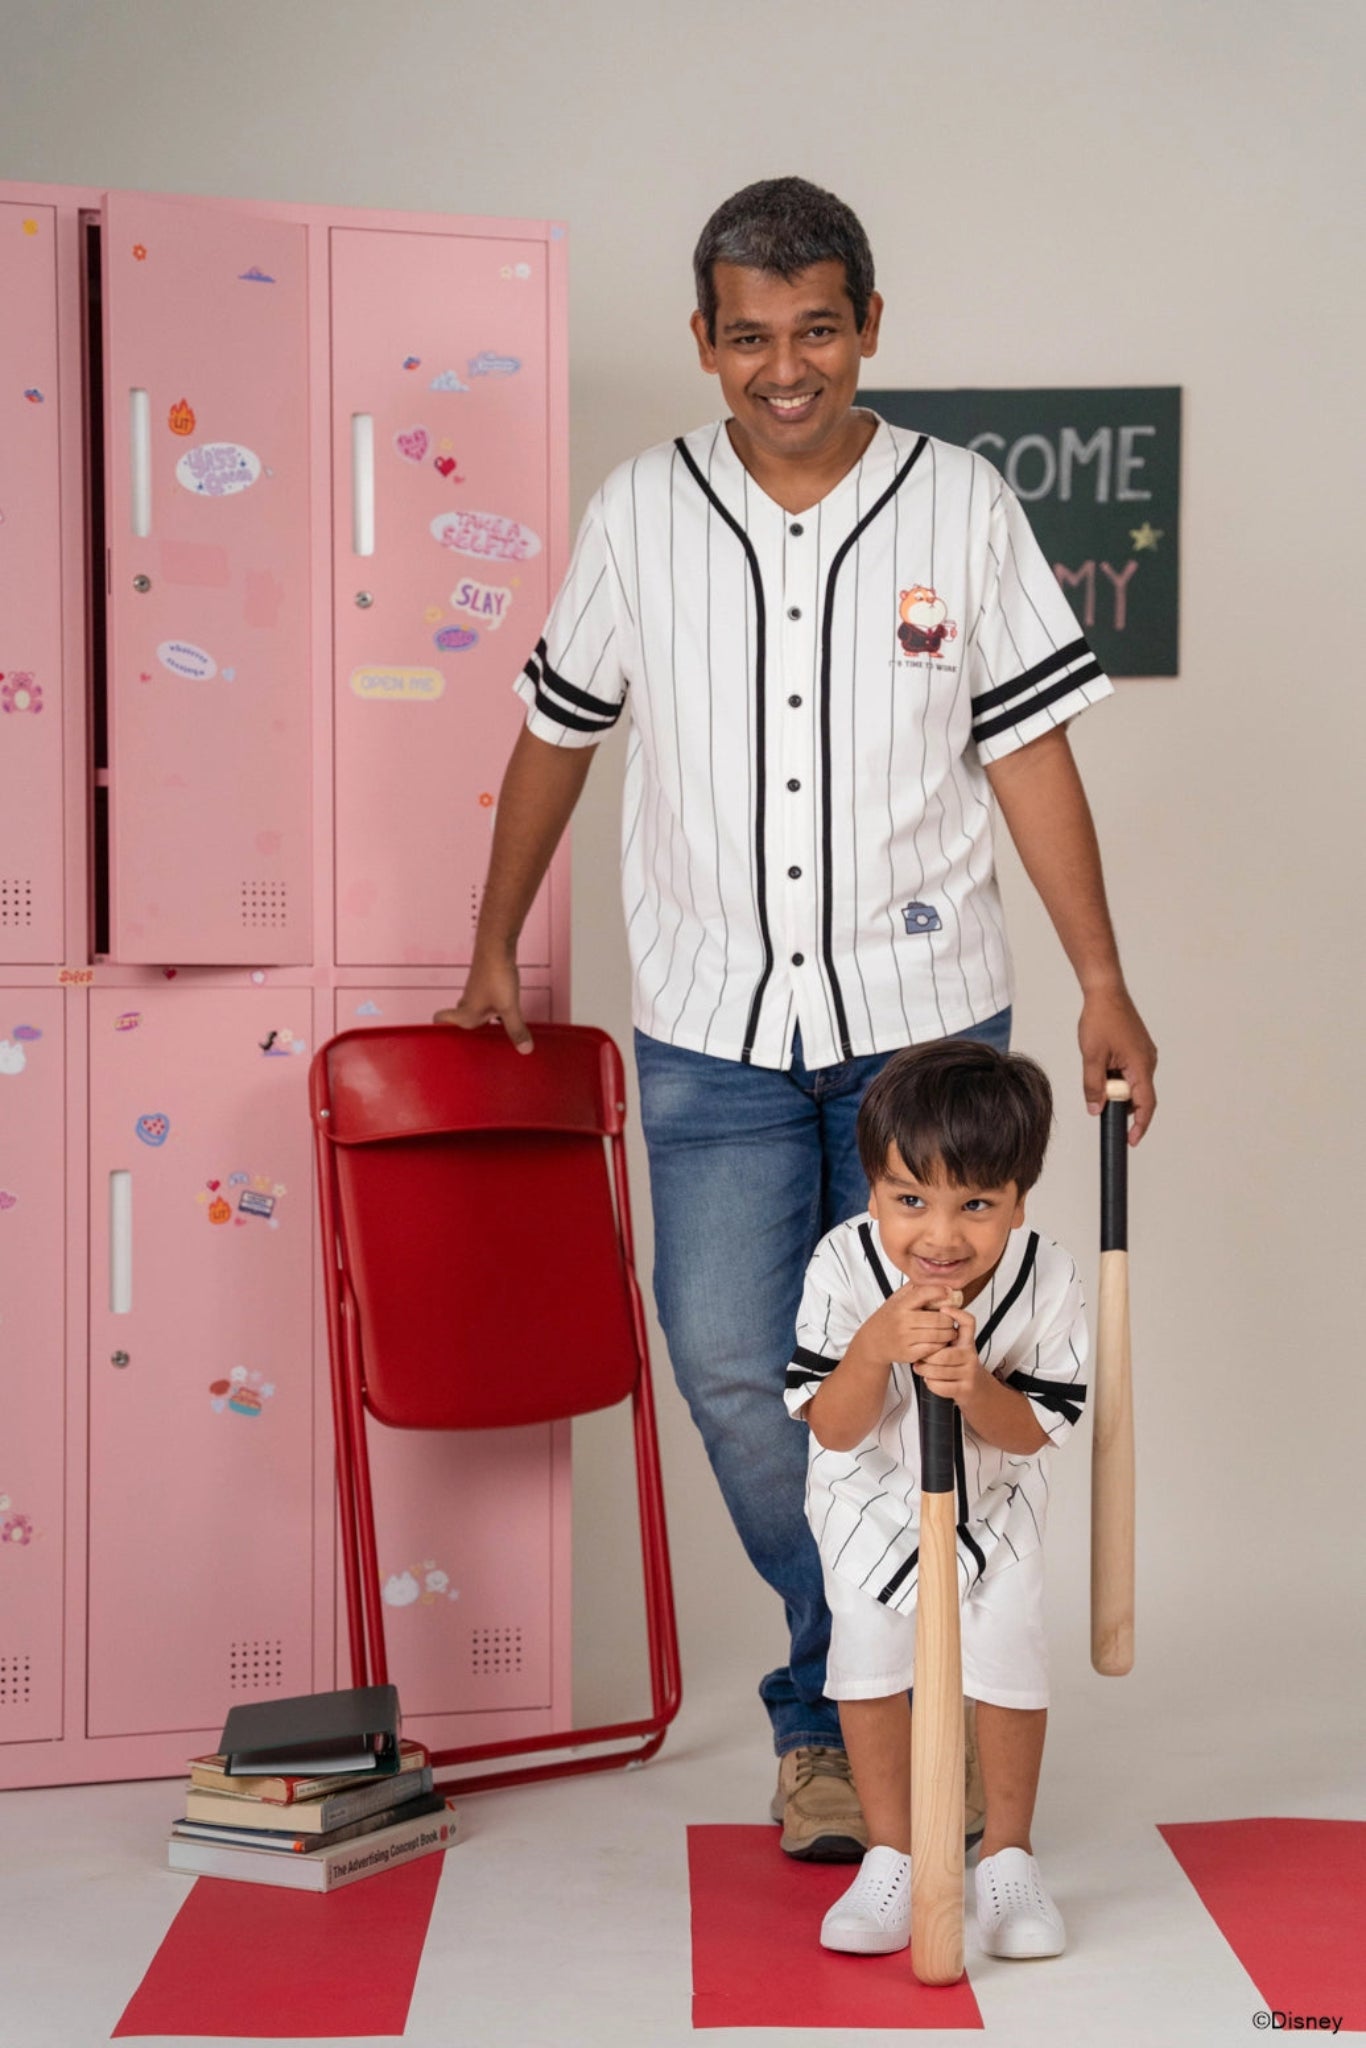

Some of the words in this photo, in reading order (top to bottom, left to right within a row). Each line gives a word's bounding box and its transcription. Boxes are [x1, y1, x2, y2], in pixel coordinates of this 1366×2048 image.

[455, 584, 505, 616] SLAY
[360, 675, 404, 692] OPEN
[409, 676, 436, 692] ME
[333, 1864, 347, 1879] The
[347, 1848, 390, 1873] Advertising
[390, 1836, 420, 1858] Concept
[420, 1829, 438, 1847] Book
